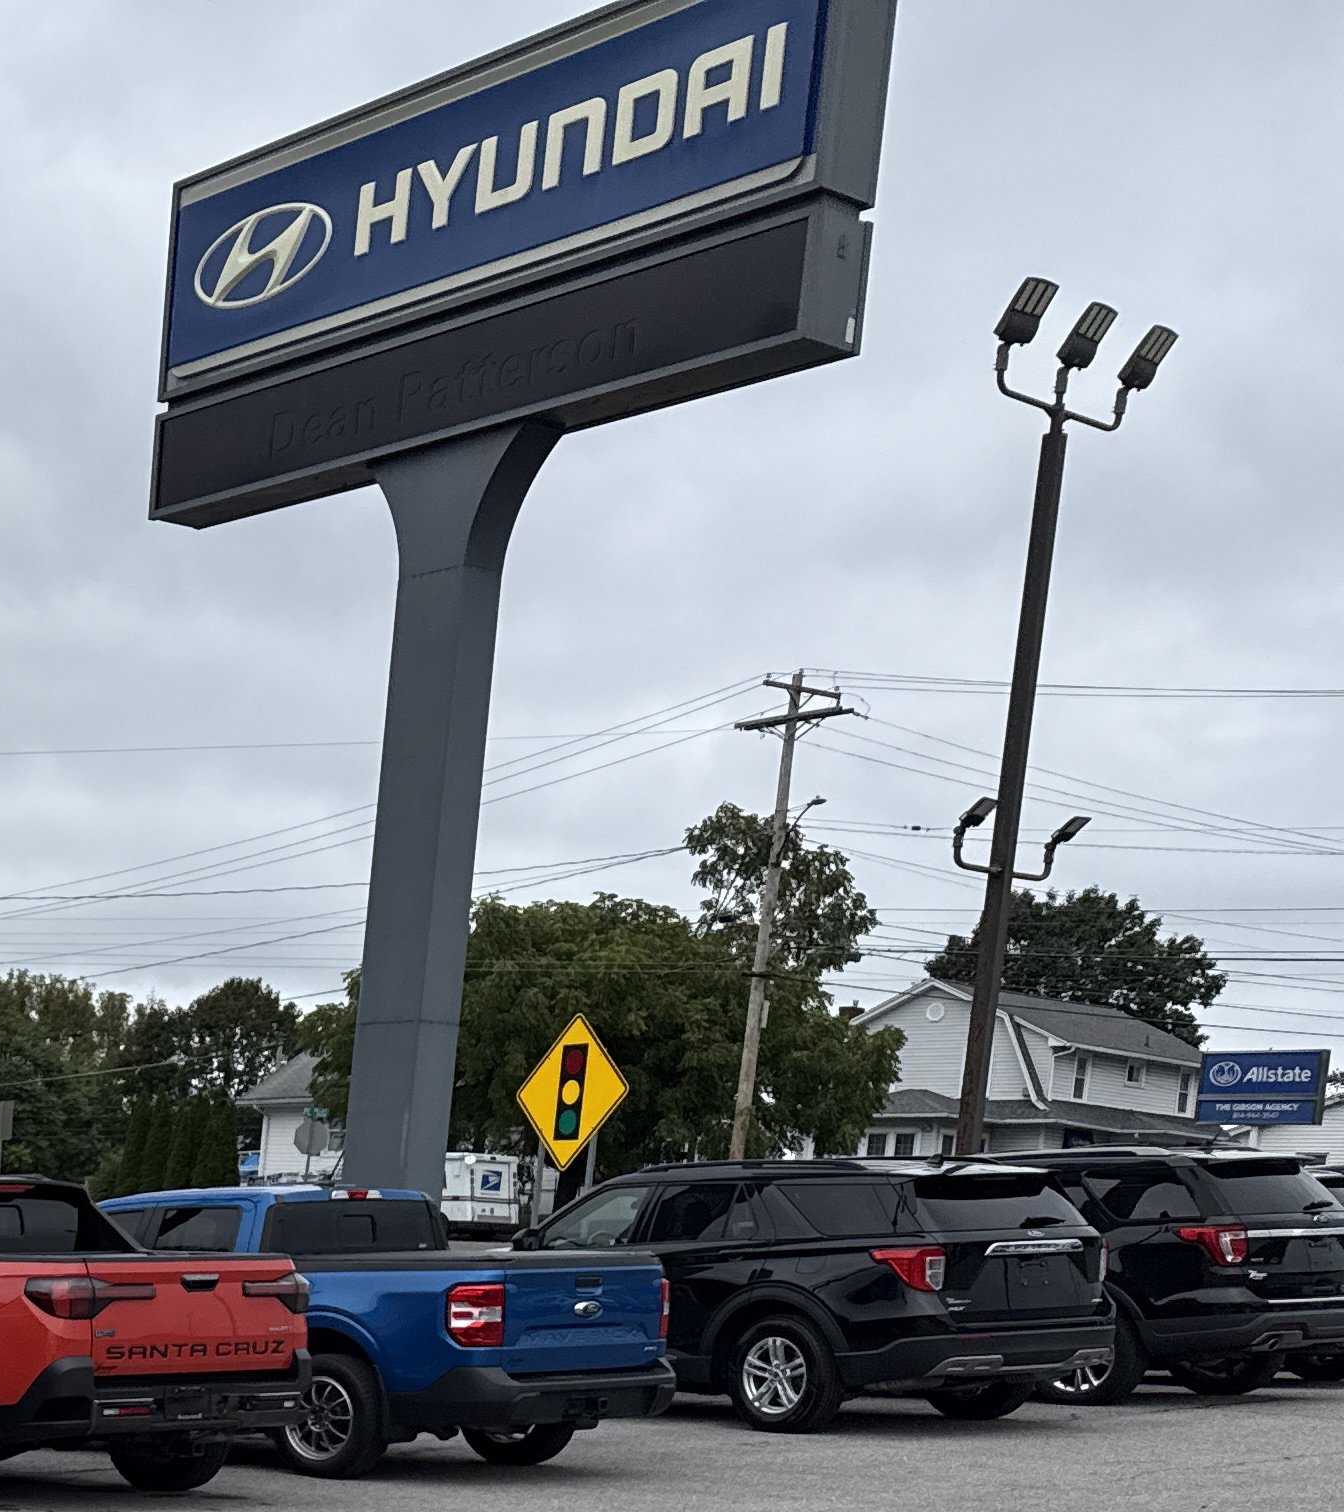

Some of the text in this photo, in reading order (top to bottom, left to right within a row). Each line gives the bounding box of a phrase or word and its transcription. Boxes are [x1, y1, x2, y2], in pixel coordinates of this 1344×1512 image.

[354, 22, 790, 257] HYUNDAI
[267, 316, 641, 460] Dean Patterson
[1242, 1066, 1312, 1083] Allstate
[1215, 1103, 1232, 1111] THE
[1264, 1103, 1300, 1111] AGENCY
[105, 1340, 286, 1361] SANTA CRUZ
